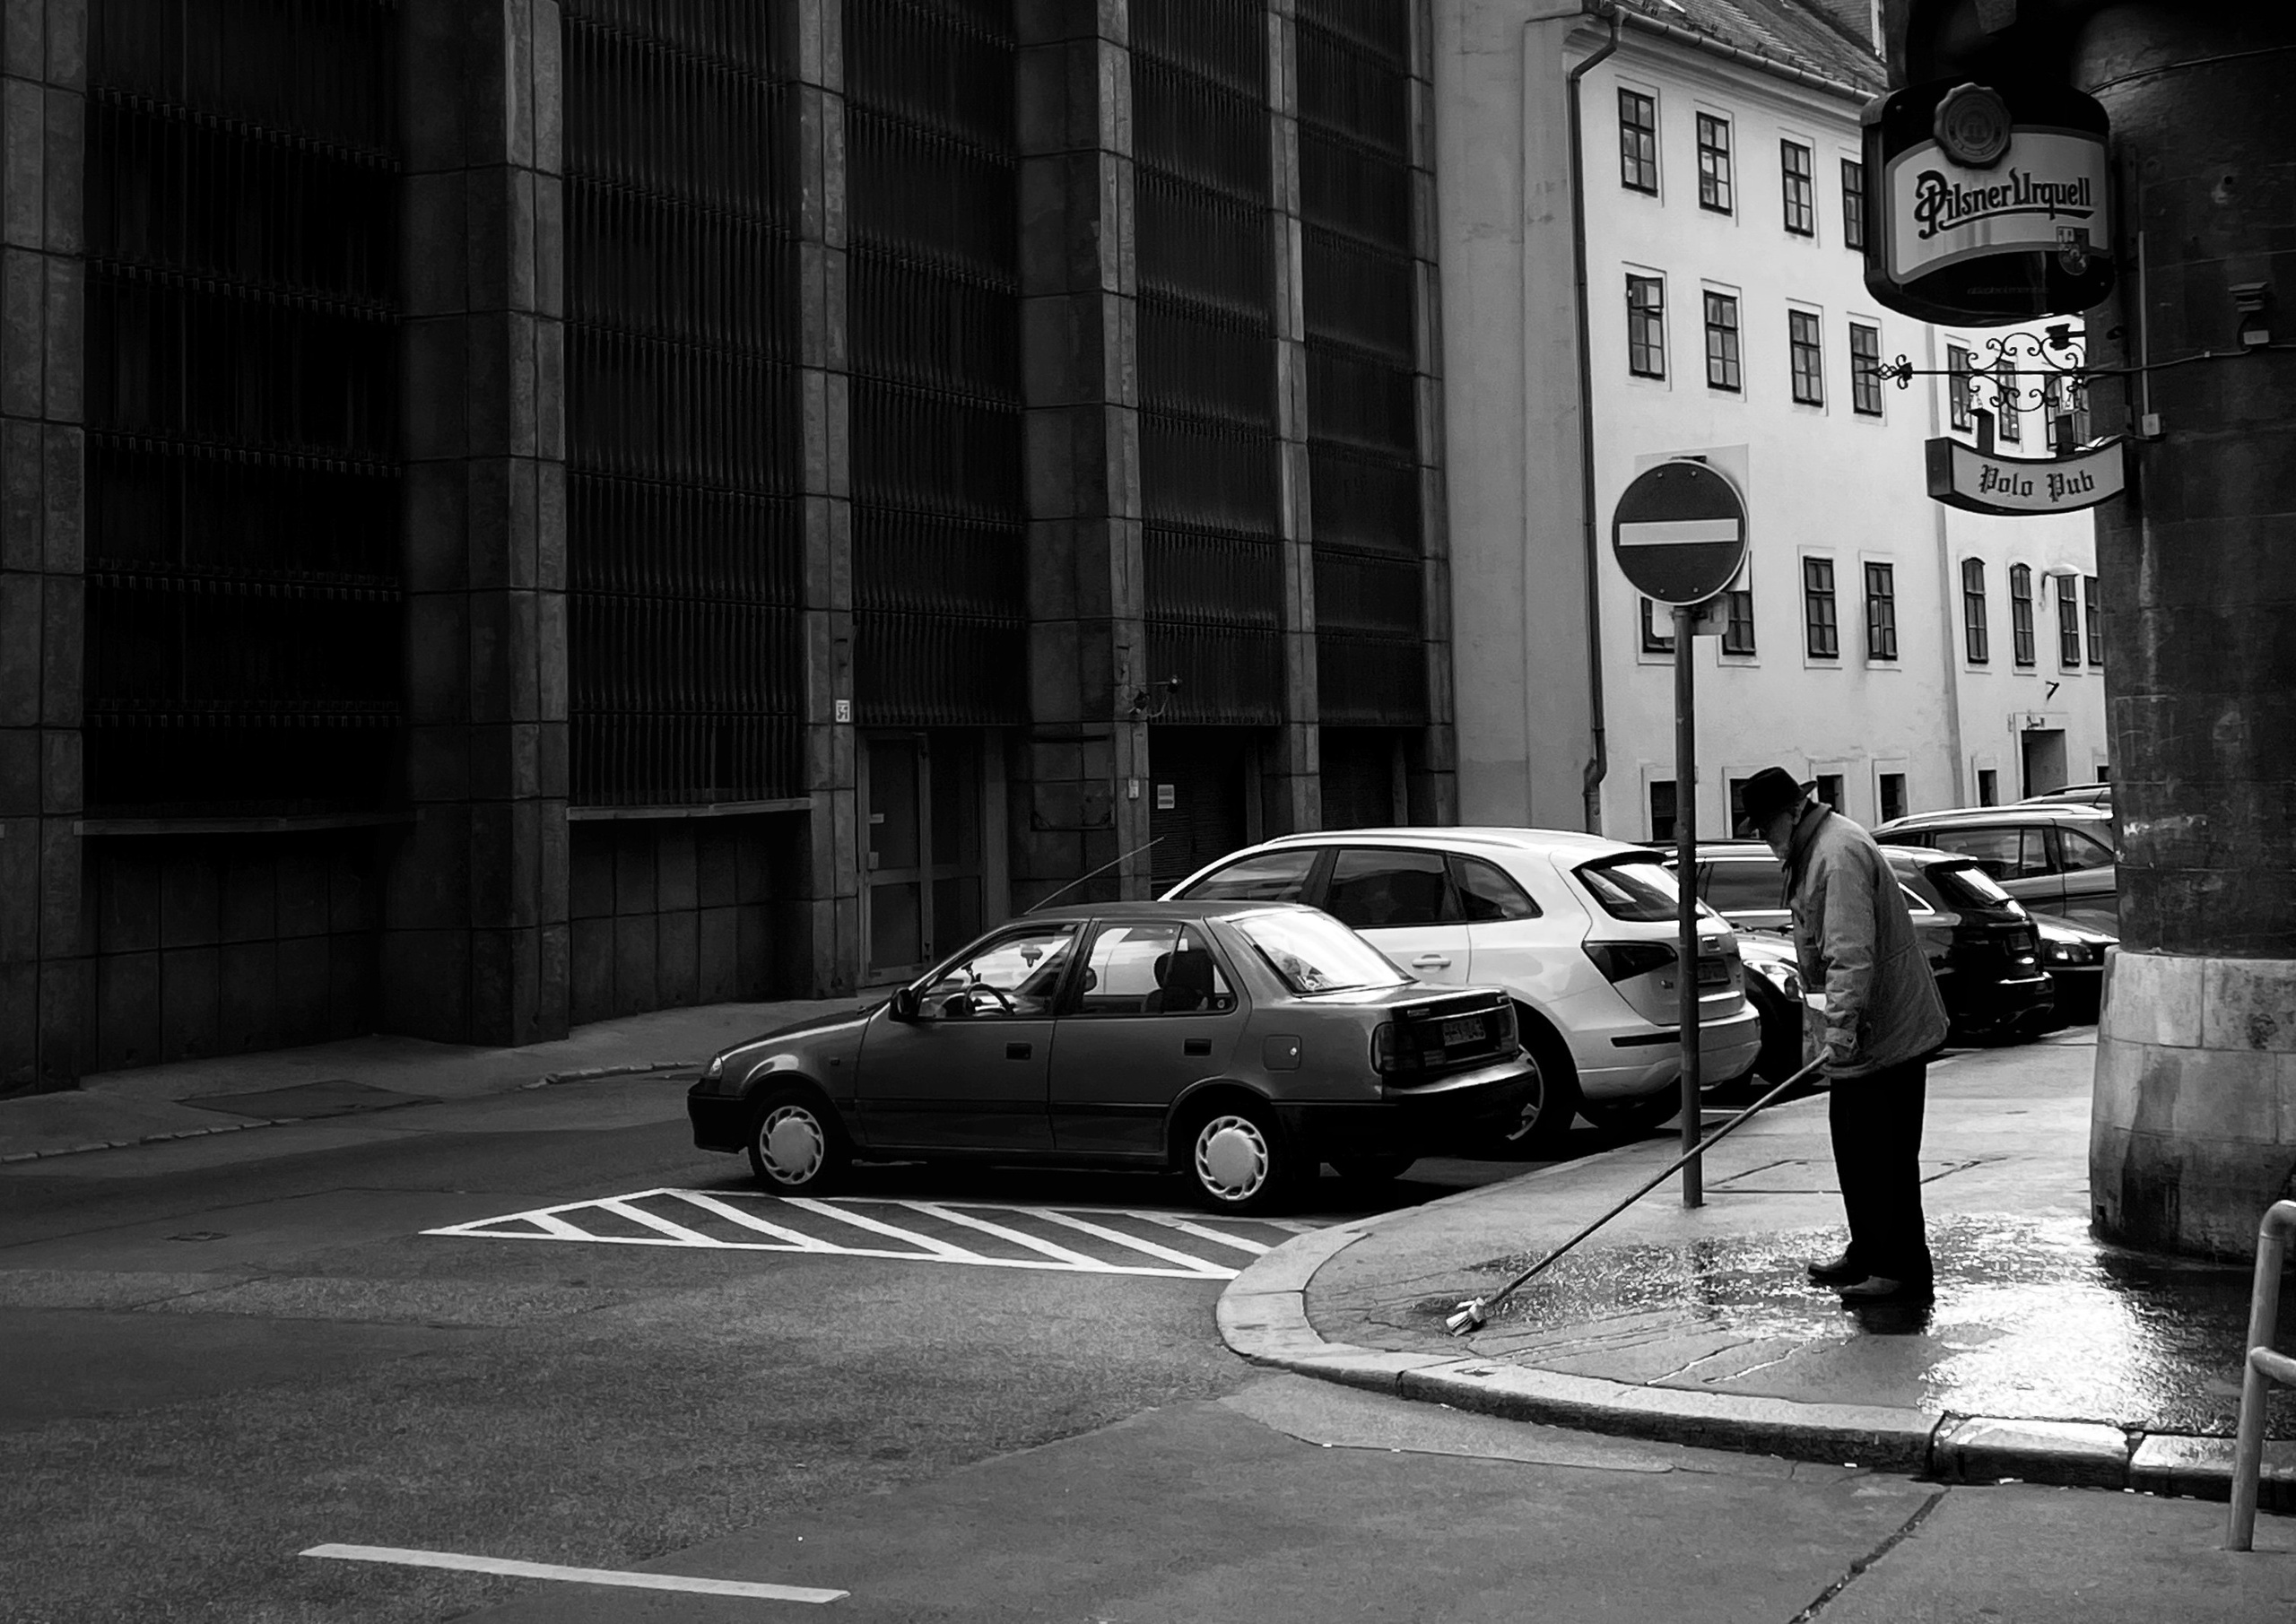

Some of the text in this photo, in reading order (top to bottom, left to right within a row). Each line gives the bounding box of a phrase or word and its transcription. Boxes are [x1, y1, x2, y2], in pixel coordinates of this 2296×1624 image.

[1914, 168, 2092, 239] Pilsner Urquell
[1979, 465, 2095, 502] Polo Pub
